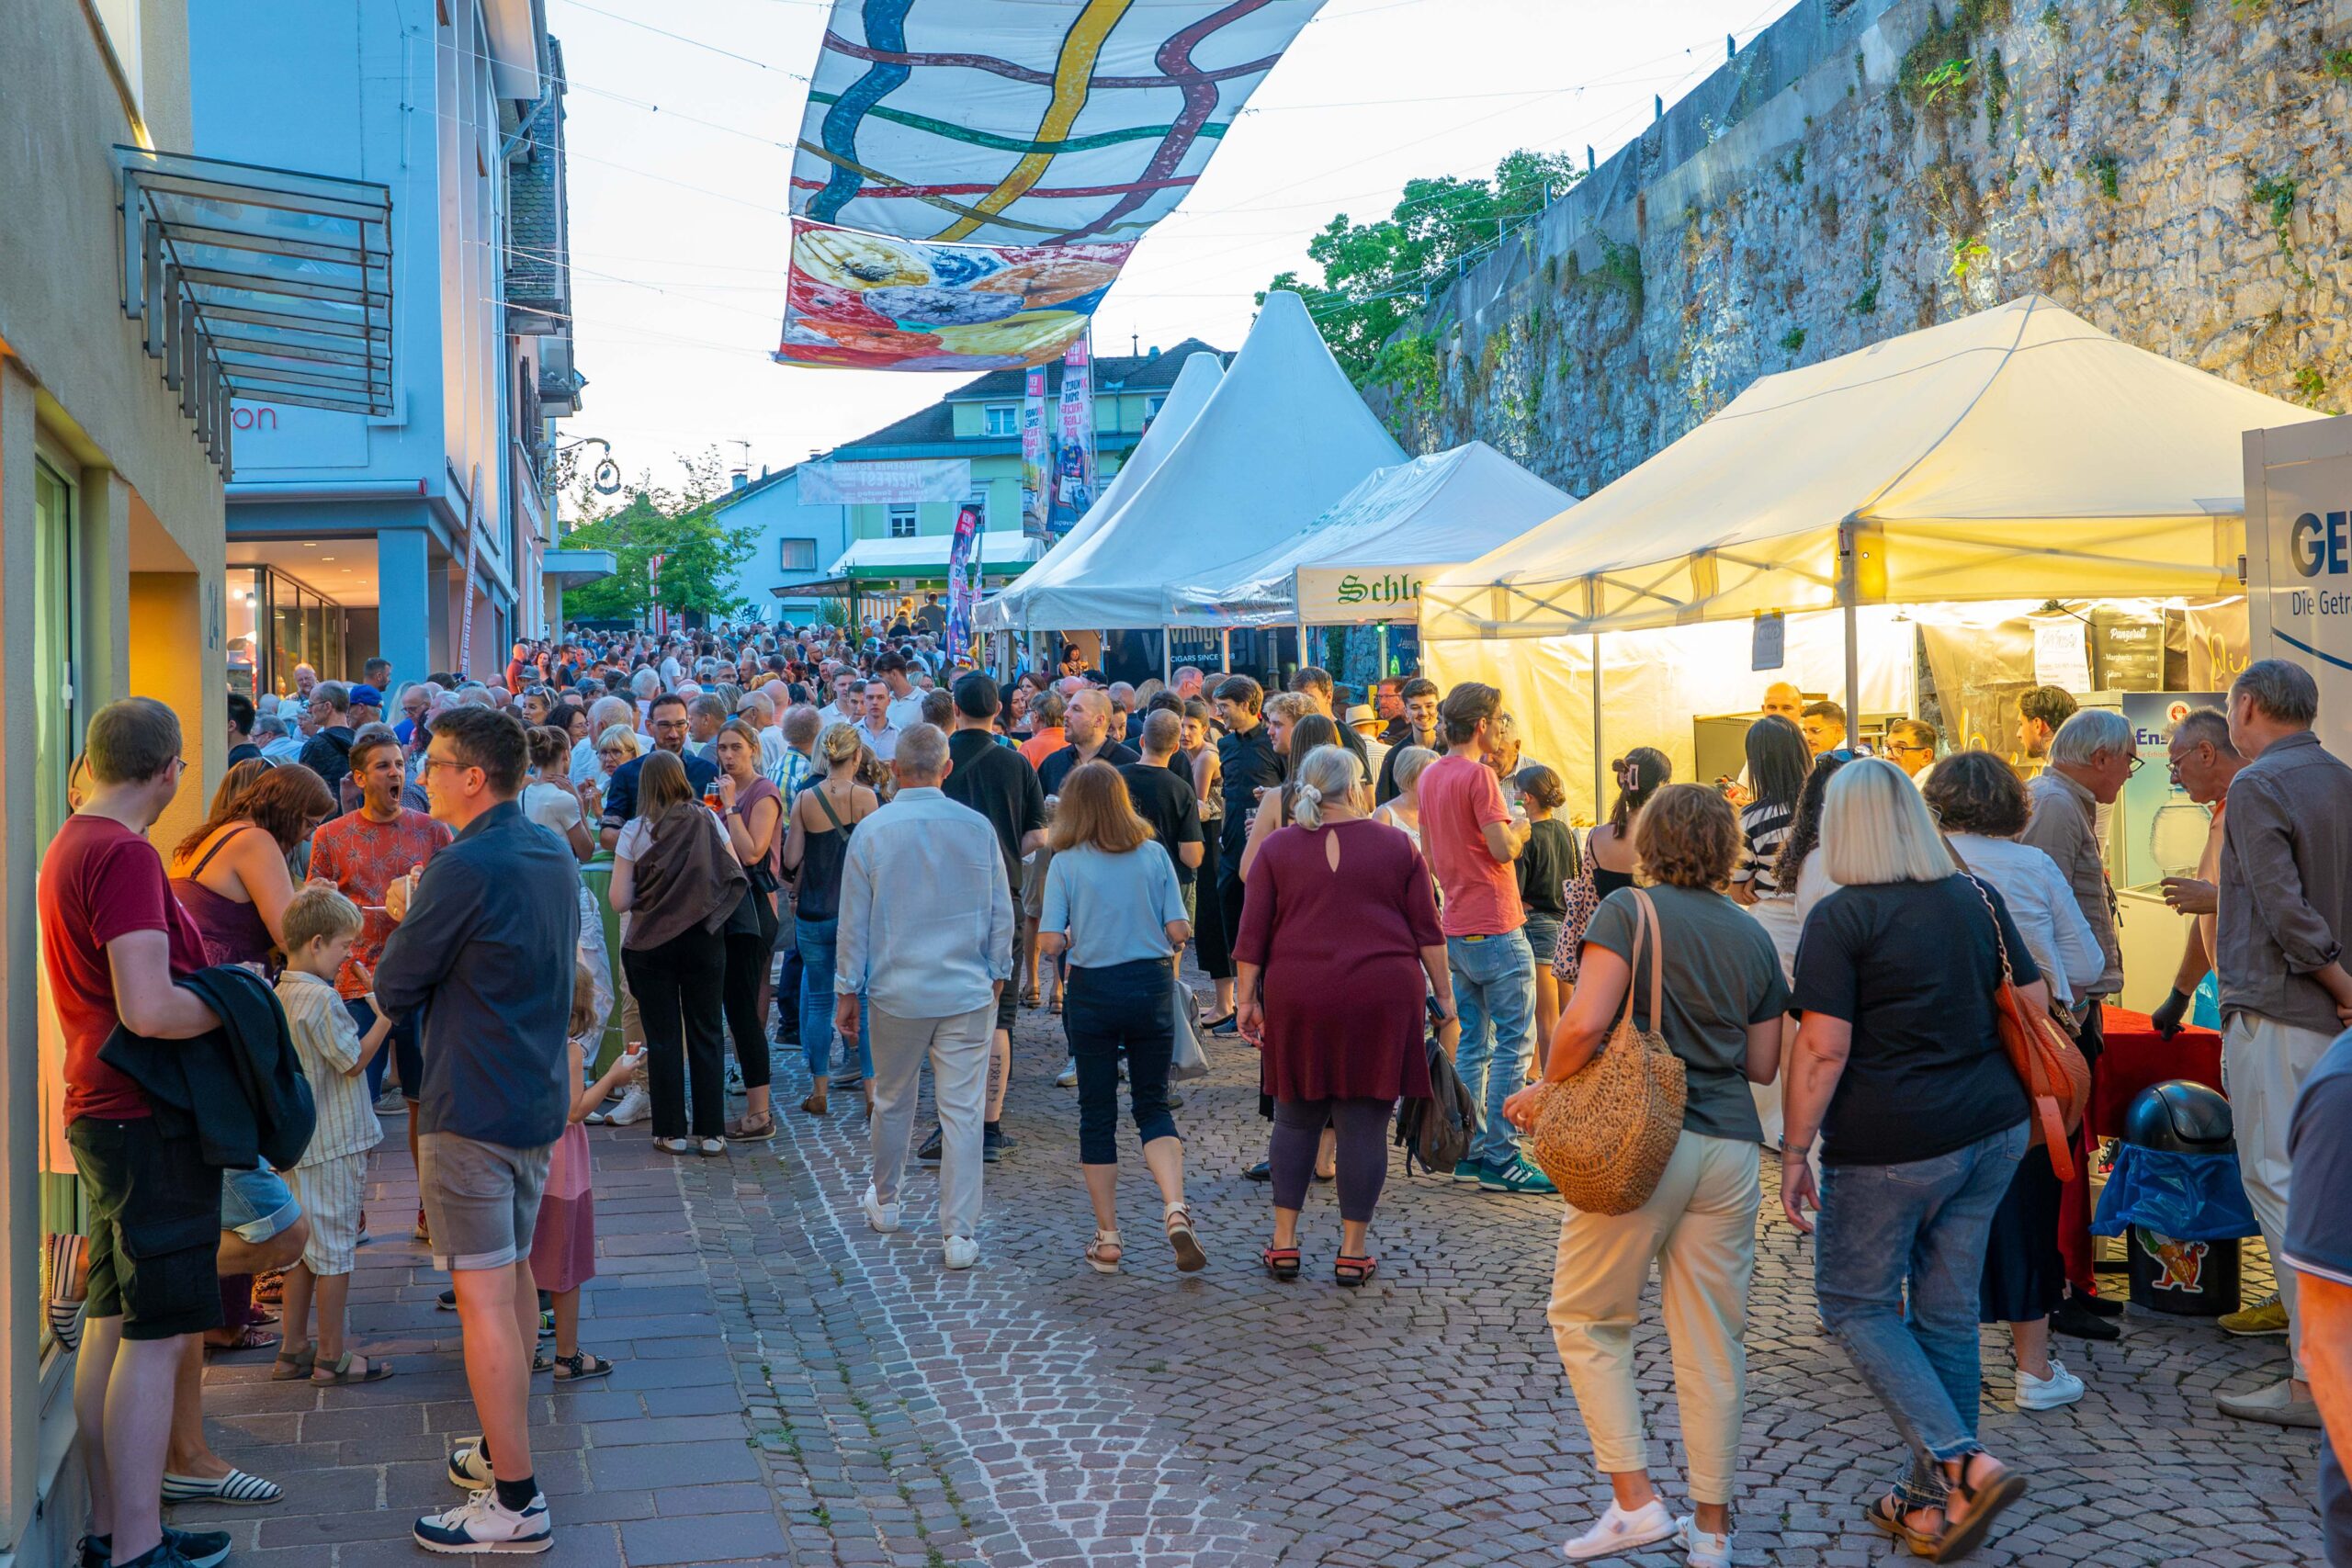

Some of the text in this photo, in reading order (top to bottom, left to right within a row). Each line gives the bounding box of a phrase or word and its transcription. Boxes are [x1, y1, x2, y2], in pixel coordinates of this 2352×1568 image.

[232, 407, 277, 430] on
[2291, 511, 2352, 578] GE
[2292, 591, 2352, 615] Die Getr
[1170, 654, 1196, 662] CIGARS
[1197, 653, 1219, 661] SINCE
